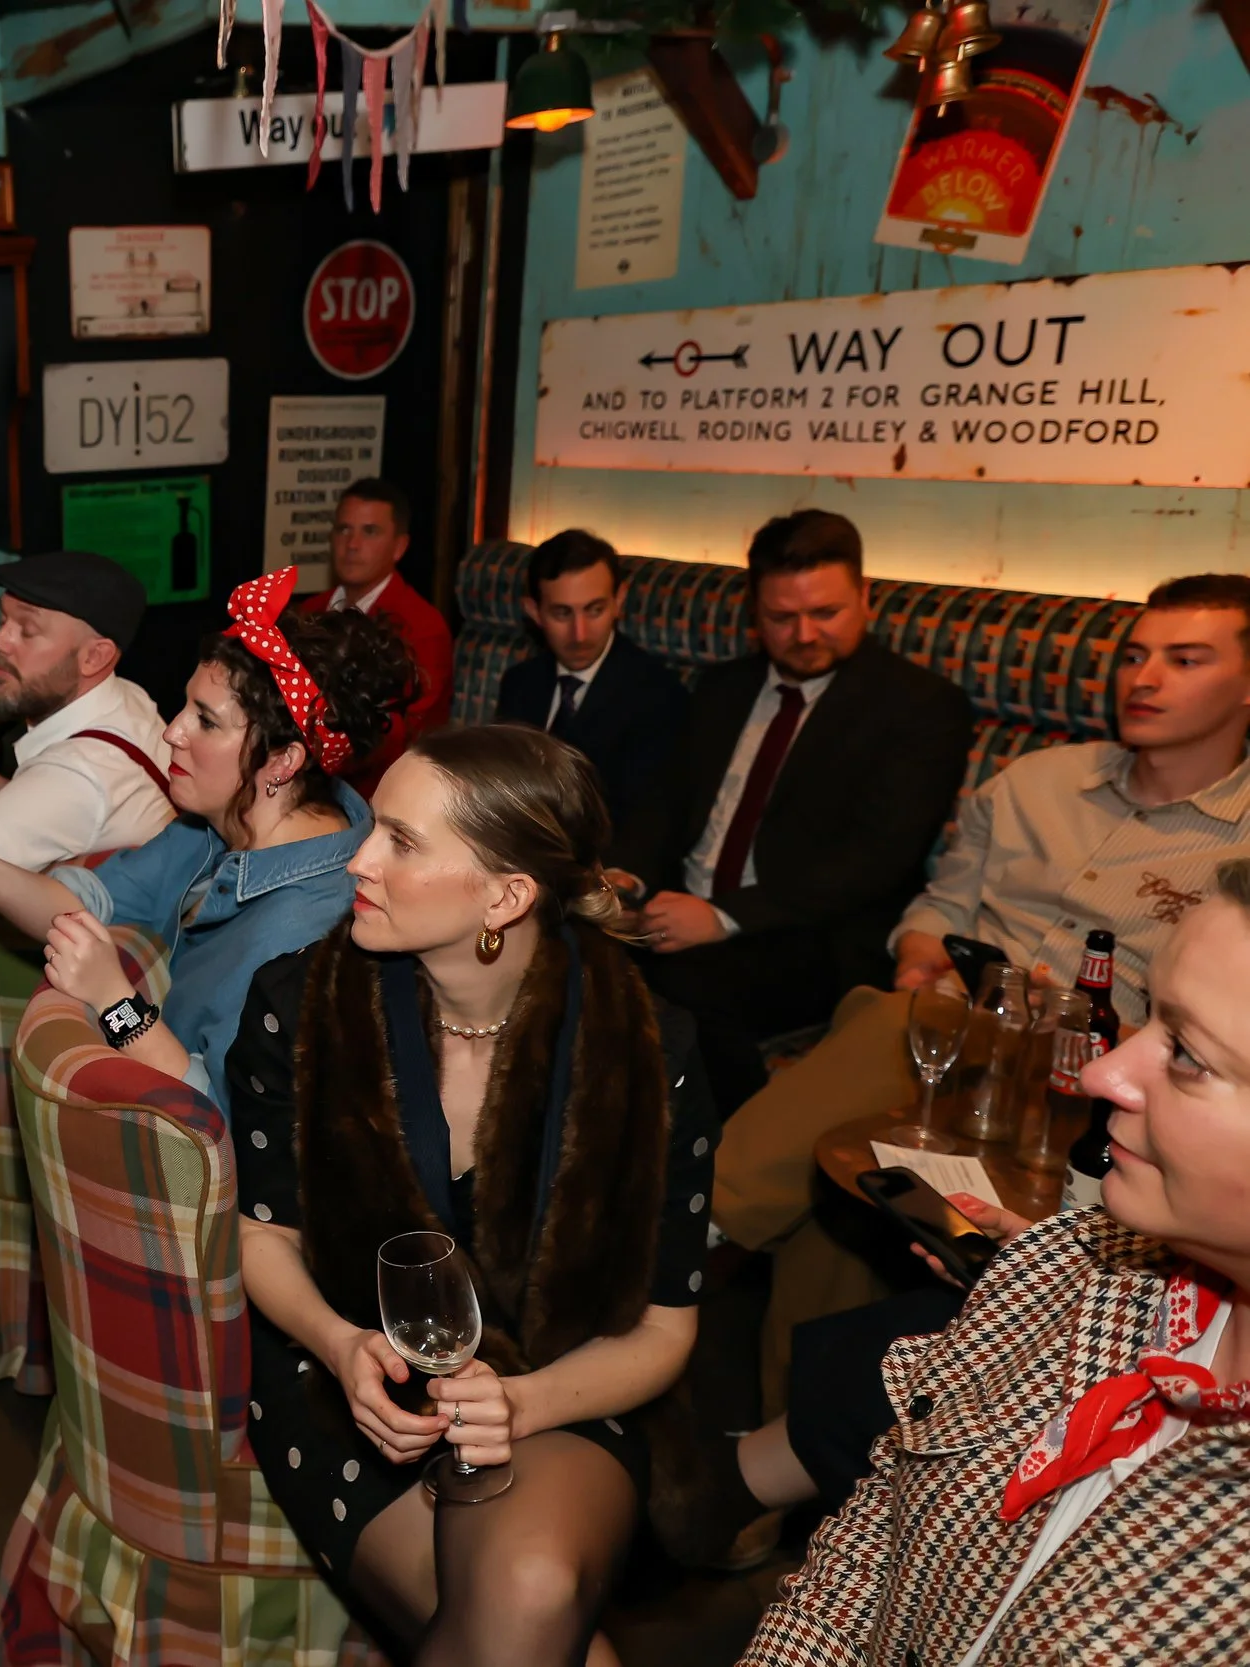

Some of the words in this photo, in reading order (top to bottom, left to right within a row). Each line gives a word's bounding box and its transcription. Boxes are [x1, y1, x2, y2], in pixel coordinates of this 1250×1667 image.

[239, 109, 302, 150] Way
[310, 109, 357, 139] ou
[921, 137, 1025, 188] WARMER
[921, 170, 1006, 213] BELOW
[320, 277, 401, 321] STOP
[788, 325, 904, 376] WAY
[941, 315, 1086, 369] OUT
[582, 390, 626, 411] AND
[640, 390, 668, 410] TO
[680, 386, 808, 411] PLATFORM
[821, 387, 834, 409] 2
[846, 384, 900, 408] FOR
[920, 380, 1059, 407] GRANGE
[1078, 377, 1166, 407] HILL,
[276, 426, 377, 441] UNDERGROUND
[697, 419, 792, 443] RODING
[808, 419, 907, 443] VALLEY
[918, 420, 938, 444] &
[952, 419, 1159, 445] WOODFORD
[278, 447, 354, 462] RUMBLINGS
[358, 447, 373, 460] IN
[297, 468, 352, 483] DISUSED
[275, 490, 327, 505] STATION
[291, 510, 334, 525] RUMO
[117, 1002, 141, 1028] 39
